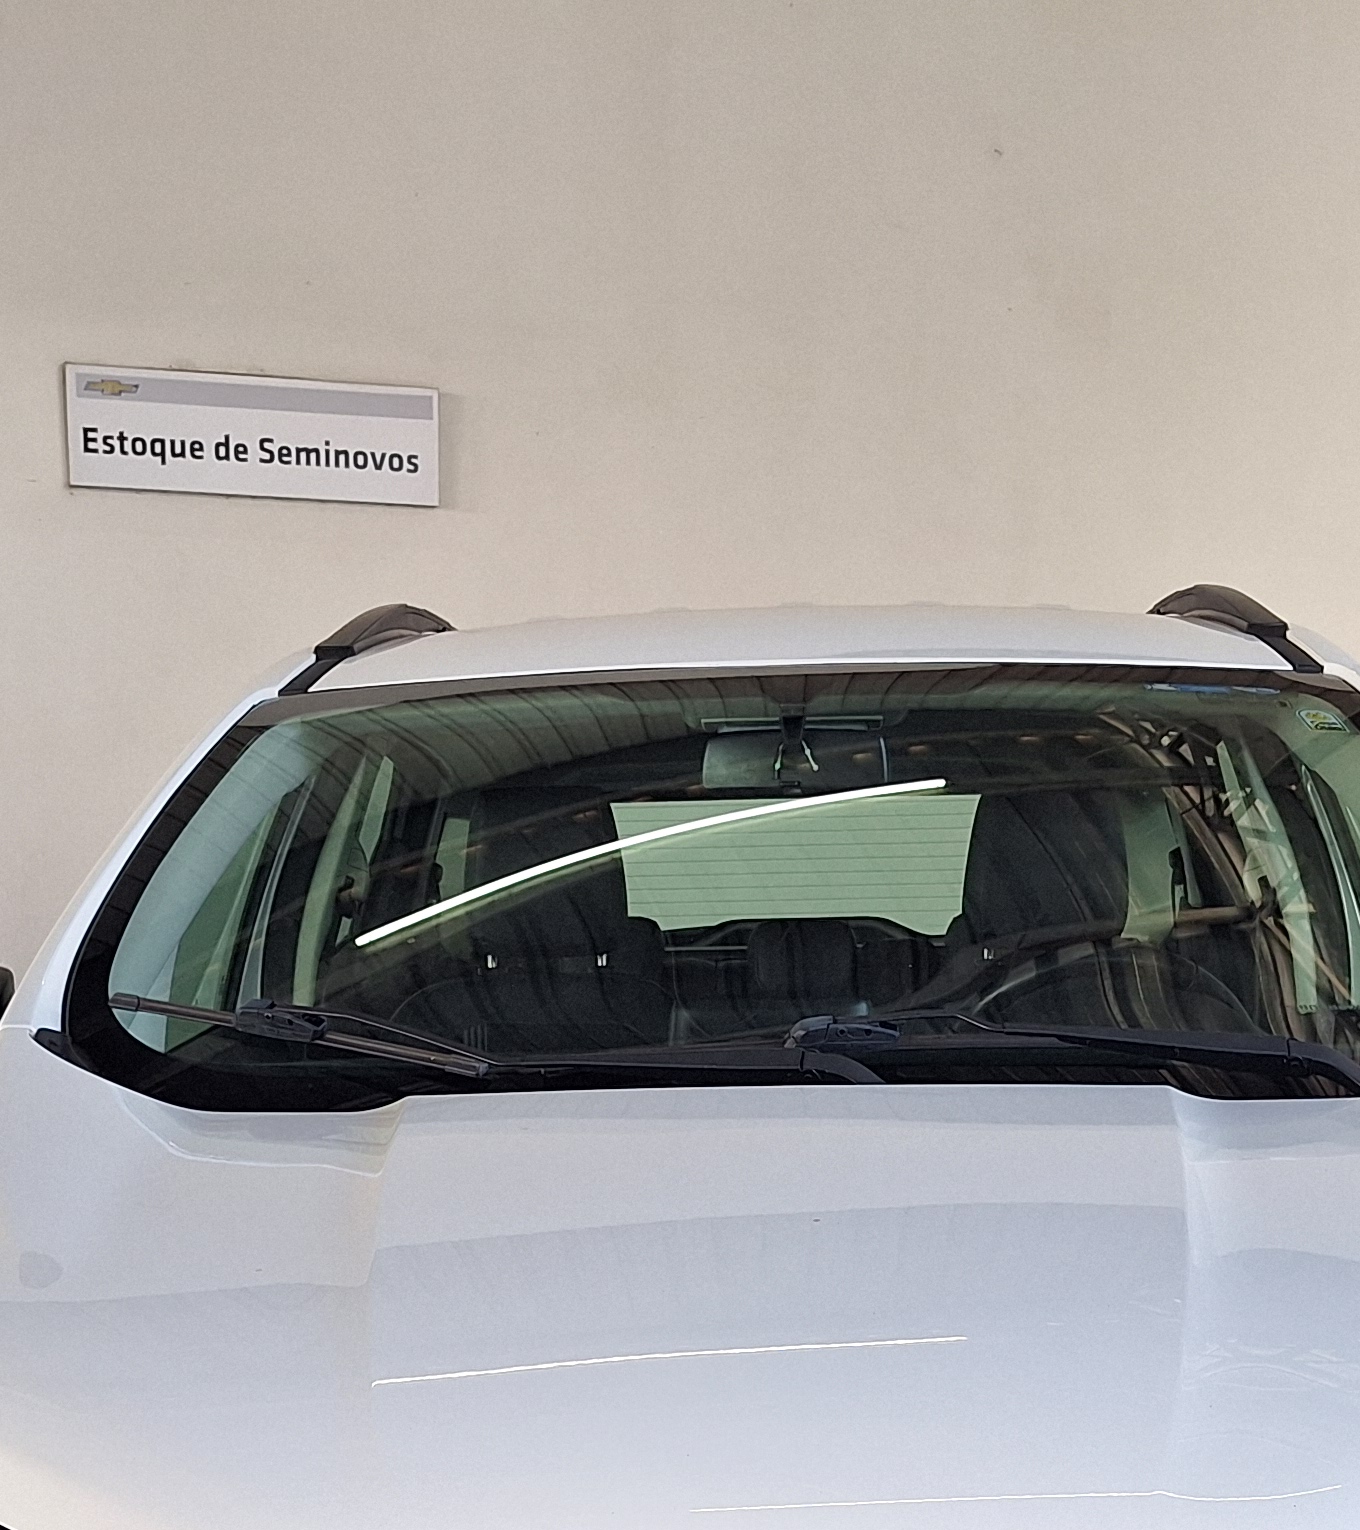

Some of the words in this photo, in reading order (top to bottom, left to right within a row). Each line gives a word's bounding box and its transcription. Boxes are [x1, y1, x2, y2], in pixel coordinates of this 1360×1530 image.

[81, 426, 205, 466] Estoque
[213, 433, 249, 463] de
[258, 437, 420, 474] Seminovos
